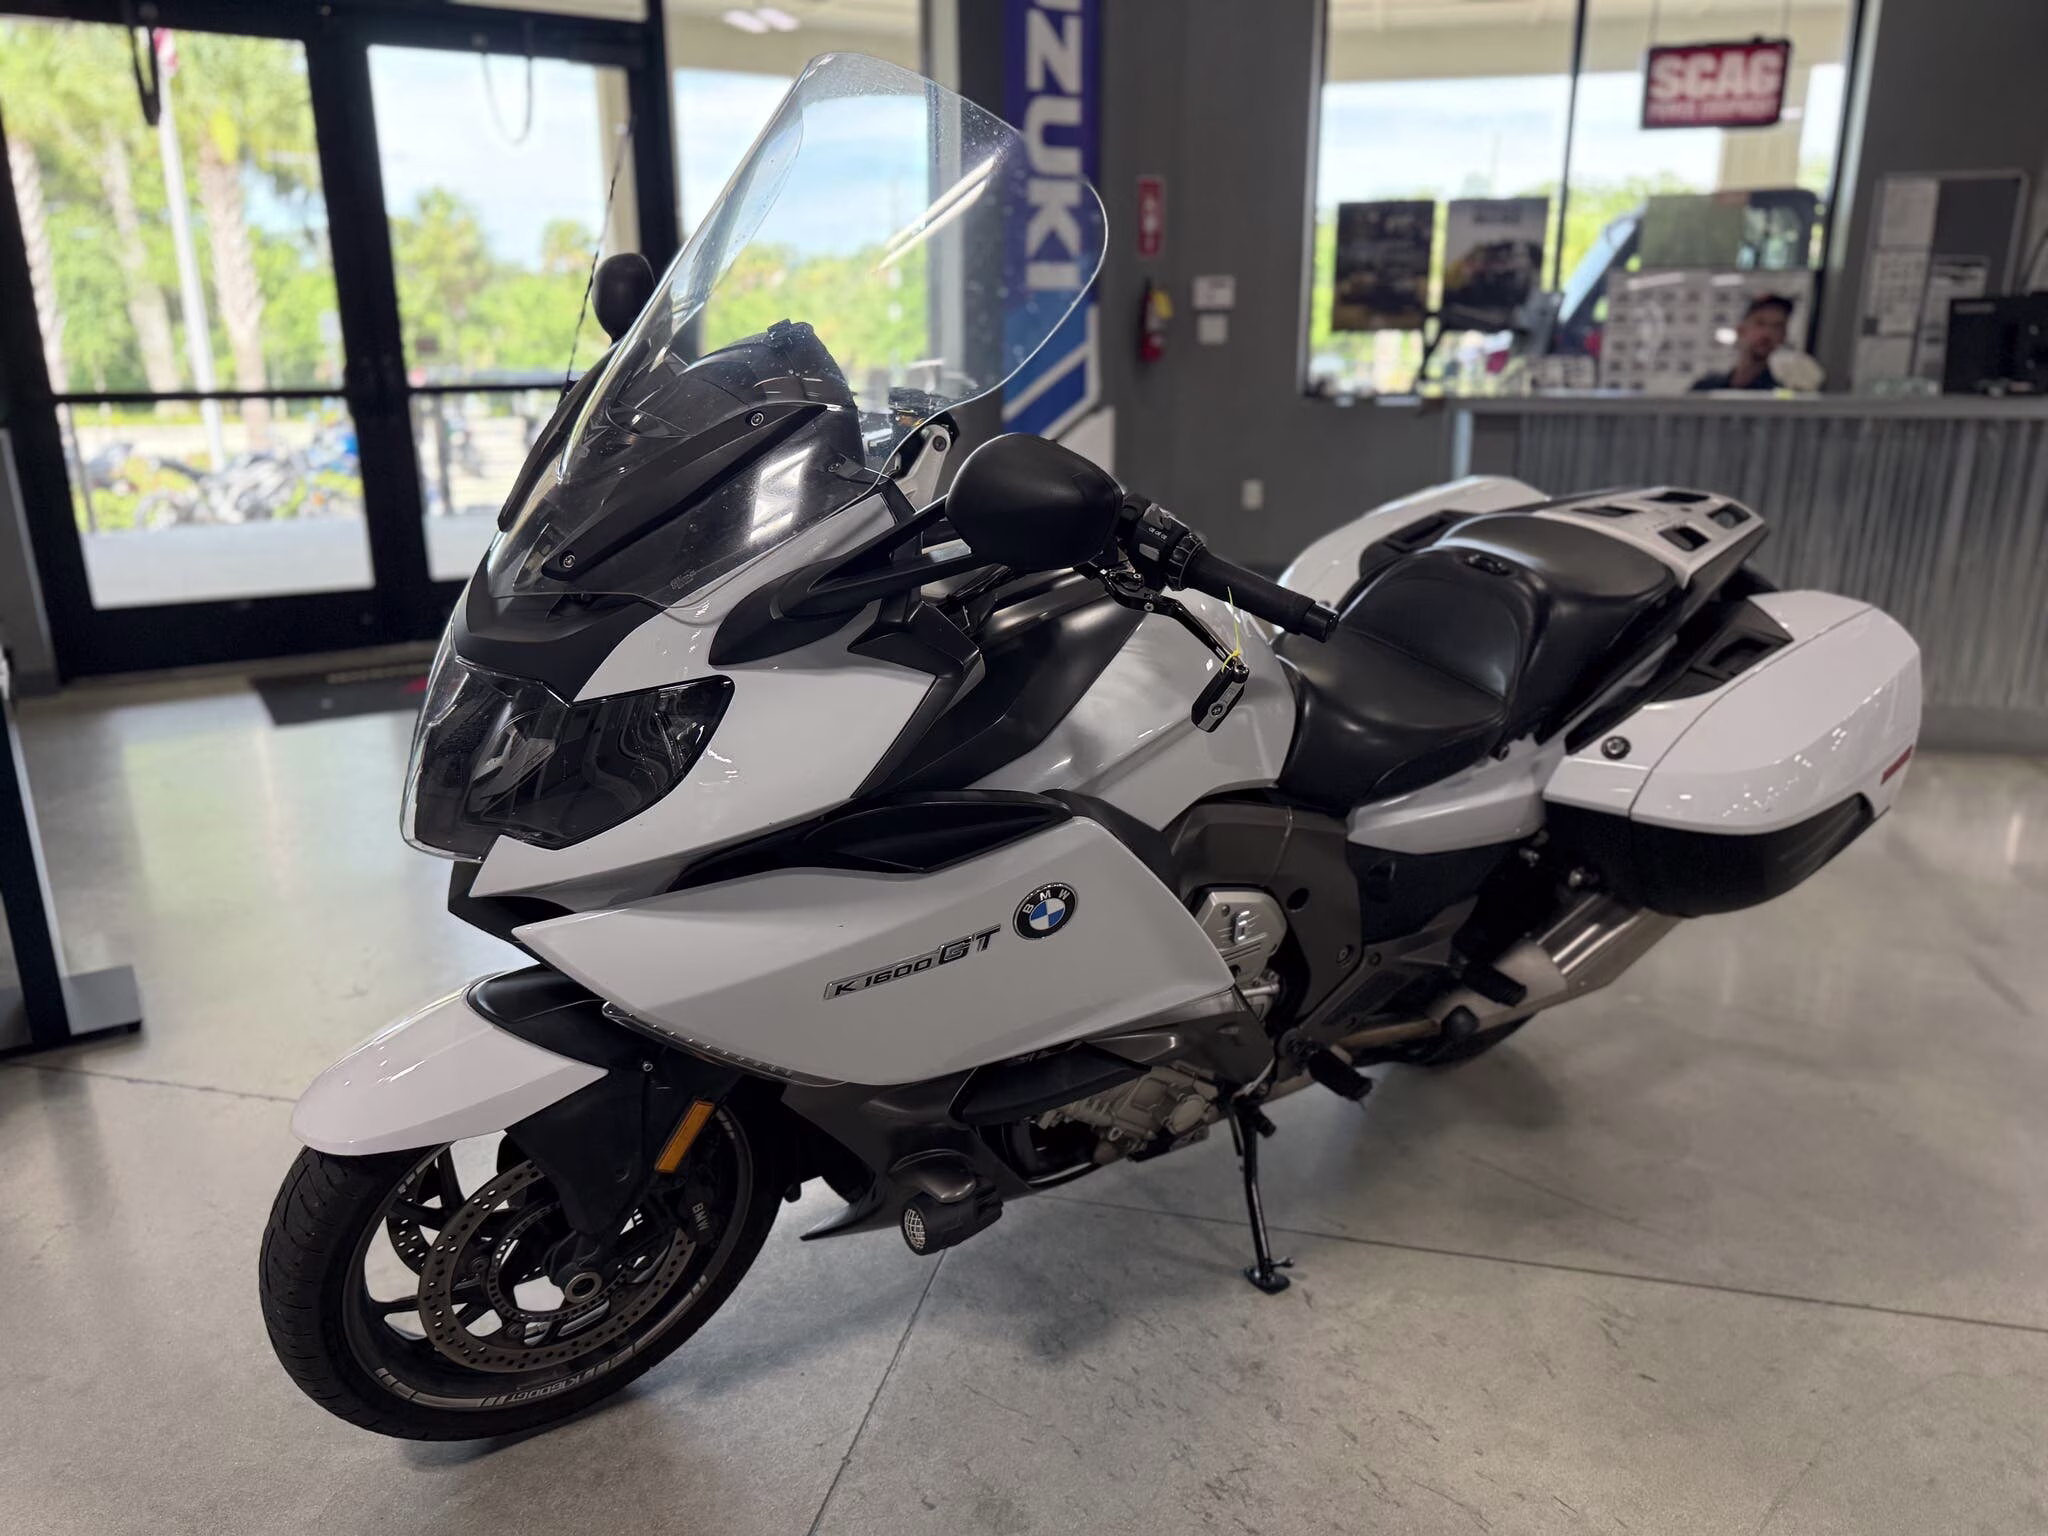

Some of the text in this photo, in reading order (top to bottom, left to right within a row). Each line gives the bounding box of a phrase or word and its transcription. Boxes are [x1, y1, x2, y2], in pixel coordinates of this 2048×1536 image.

[1649, 50, 1784, 98] SCAG
[1024, 0, 1083, 291] ZUKI
[1022, 888, 1070, 915] BMW
[692, 1202, 710, 1231] BMW
